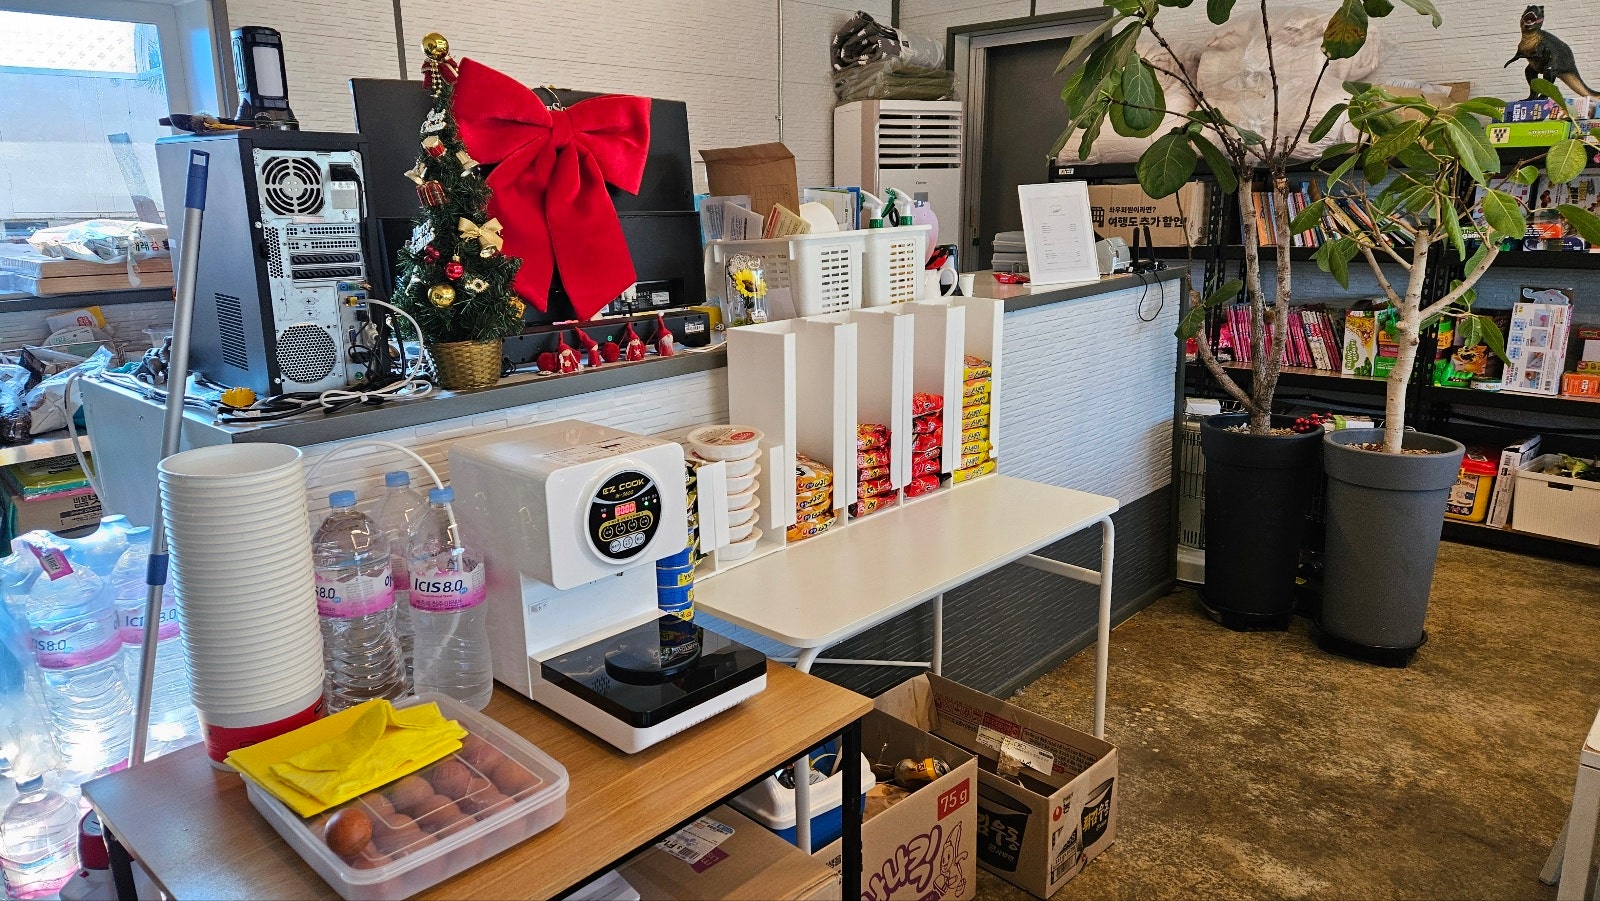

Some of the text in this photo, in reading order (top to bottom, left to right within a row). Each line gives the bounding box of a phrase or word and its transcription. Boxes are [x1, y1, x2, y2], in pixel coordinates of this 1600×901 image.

[1107, 216, 1138, 228] 여행도
[1139, 216, 1161, 228] 추가
[602, 485, 616, 495] EZ
[618, 477, 645, 491] COOK
[319, 587, 336, 599] 8.0
[414, 577, 441, 593] ICIS
[442, 579, 463, 593] 8.0
[126, 614, 144, 627] ICI
[940, 788, 968, 813] 75 g
[1082, 799, 1110, 832] 튀김우동
[977, 812, 1020, 851] 김우동
